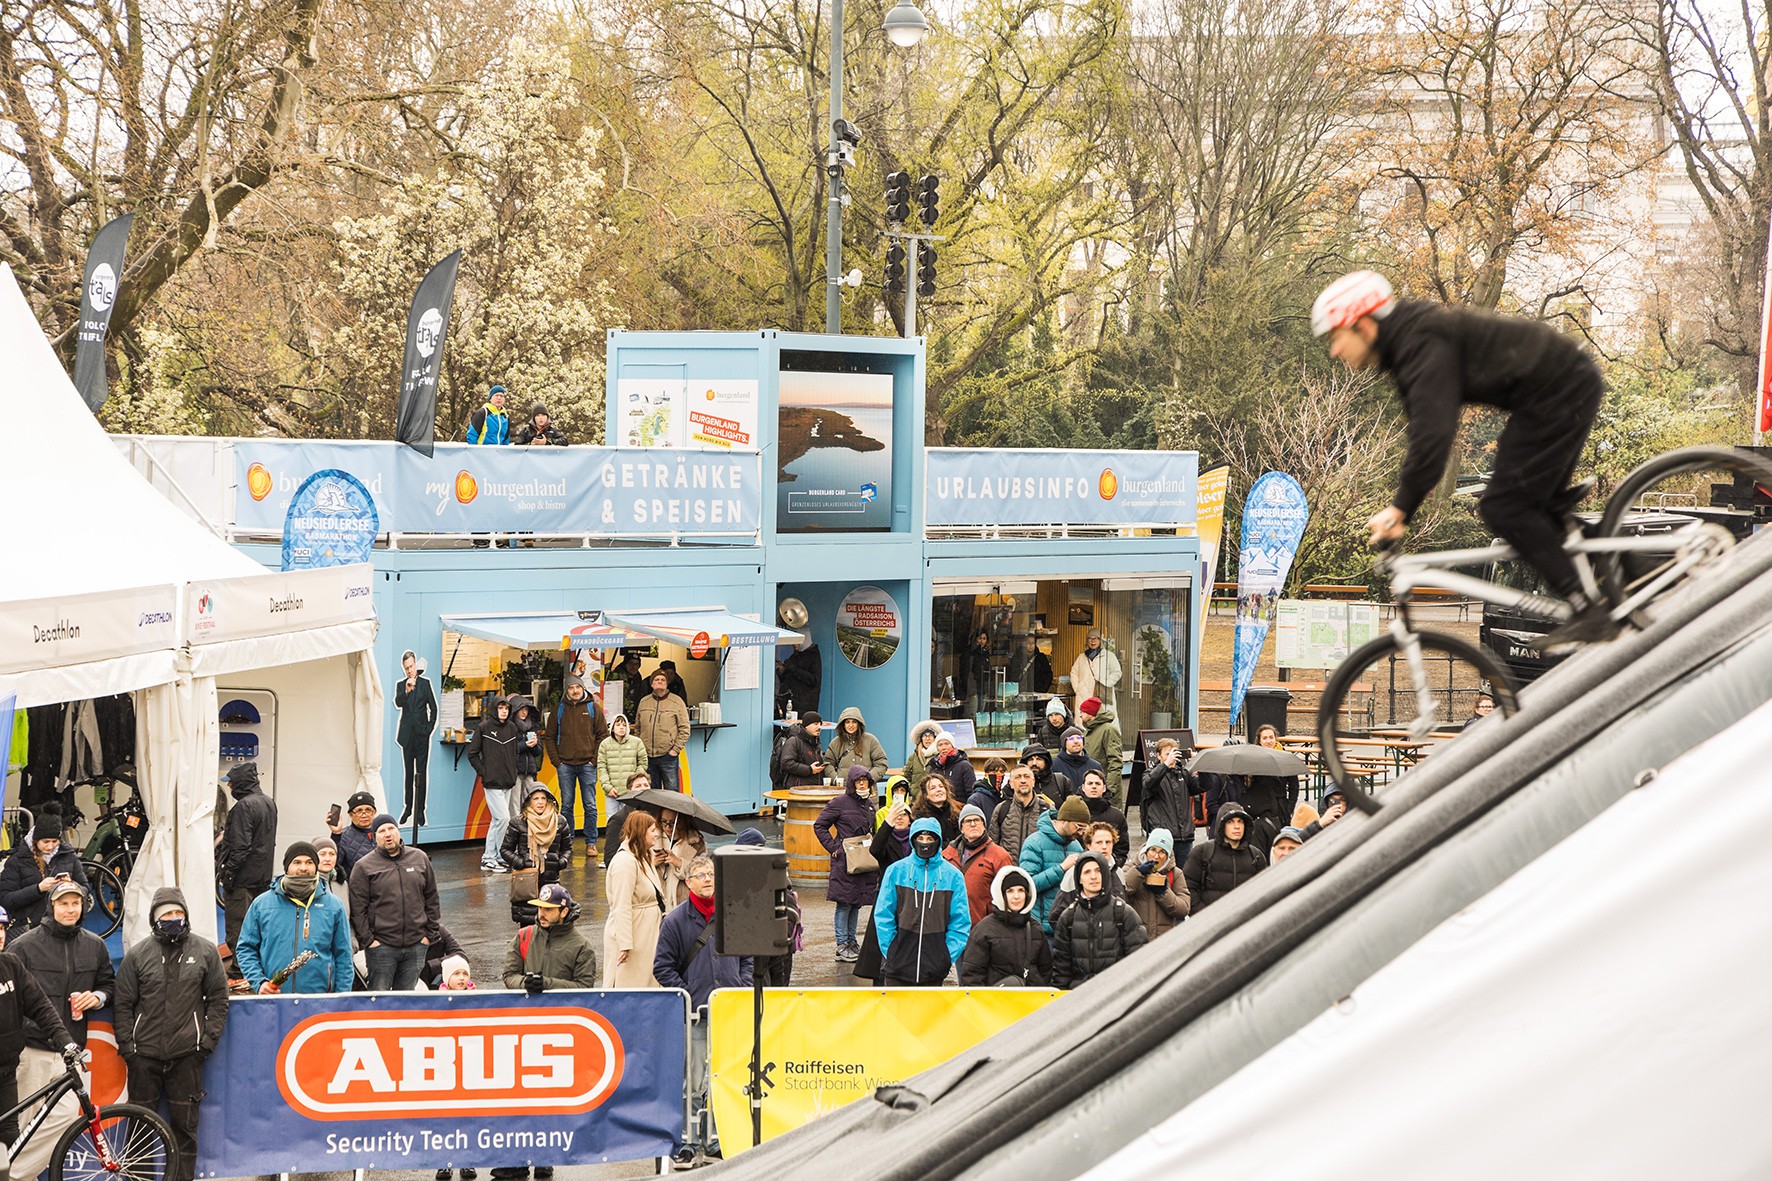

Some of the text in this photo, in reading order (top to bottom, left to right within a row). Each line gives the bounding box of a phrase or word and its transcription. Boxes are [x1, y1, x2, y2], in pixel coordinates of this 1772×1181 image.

[717, 392, 751, 400] burgenland
[691, 413, 739, 431] BURGENLAND
[704, 425, 749, 444] HIGHLIGHTS.
[601, 456, 742, 489] GETRÄNKE
[937, 476, 1089, 499] URLAUBSINFO
[1122, 475, 1185, 498] burgenland
[425, 478, 566, 516] my burgenland
[517, 500, 566, 513] shop & bistro
[601, 499, 741, 523] & SPEISEN
[1249, 507, 1308, 519] NEUSIEDLERSEE
[294, 517, 370, 532] NEUSIEDLERSEE
[270, 586, 370, 613] Decathlon DECATHLON
[858, 603, 885, 612] LÄNGSTE
[854, 619, 895, 627] ÖSTERREICHS
[857, 612, 893, 620] RADSAISON
[34, 612, 173, 644] Decathlon DECATHLON
[572, 636, 624, 645] PFANDRÜCKGABE
[731, 635, 776, 645] BESTELLUNG
[1509, 646, 1540, 659] MAN
[327, 1033, 574, 1094] ABUS
[785, 1060, 864, 1075] Raiffeisen
[785, 1077, 860, 1091] Stadtbank
[326, 1128, 574, 1155] Security Tech Germany
